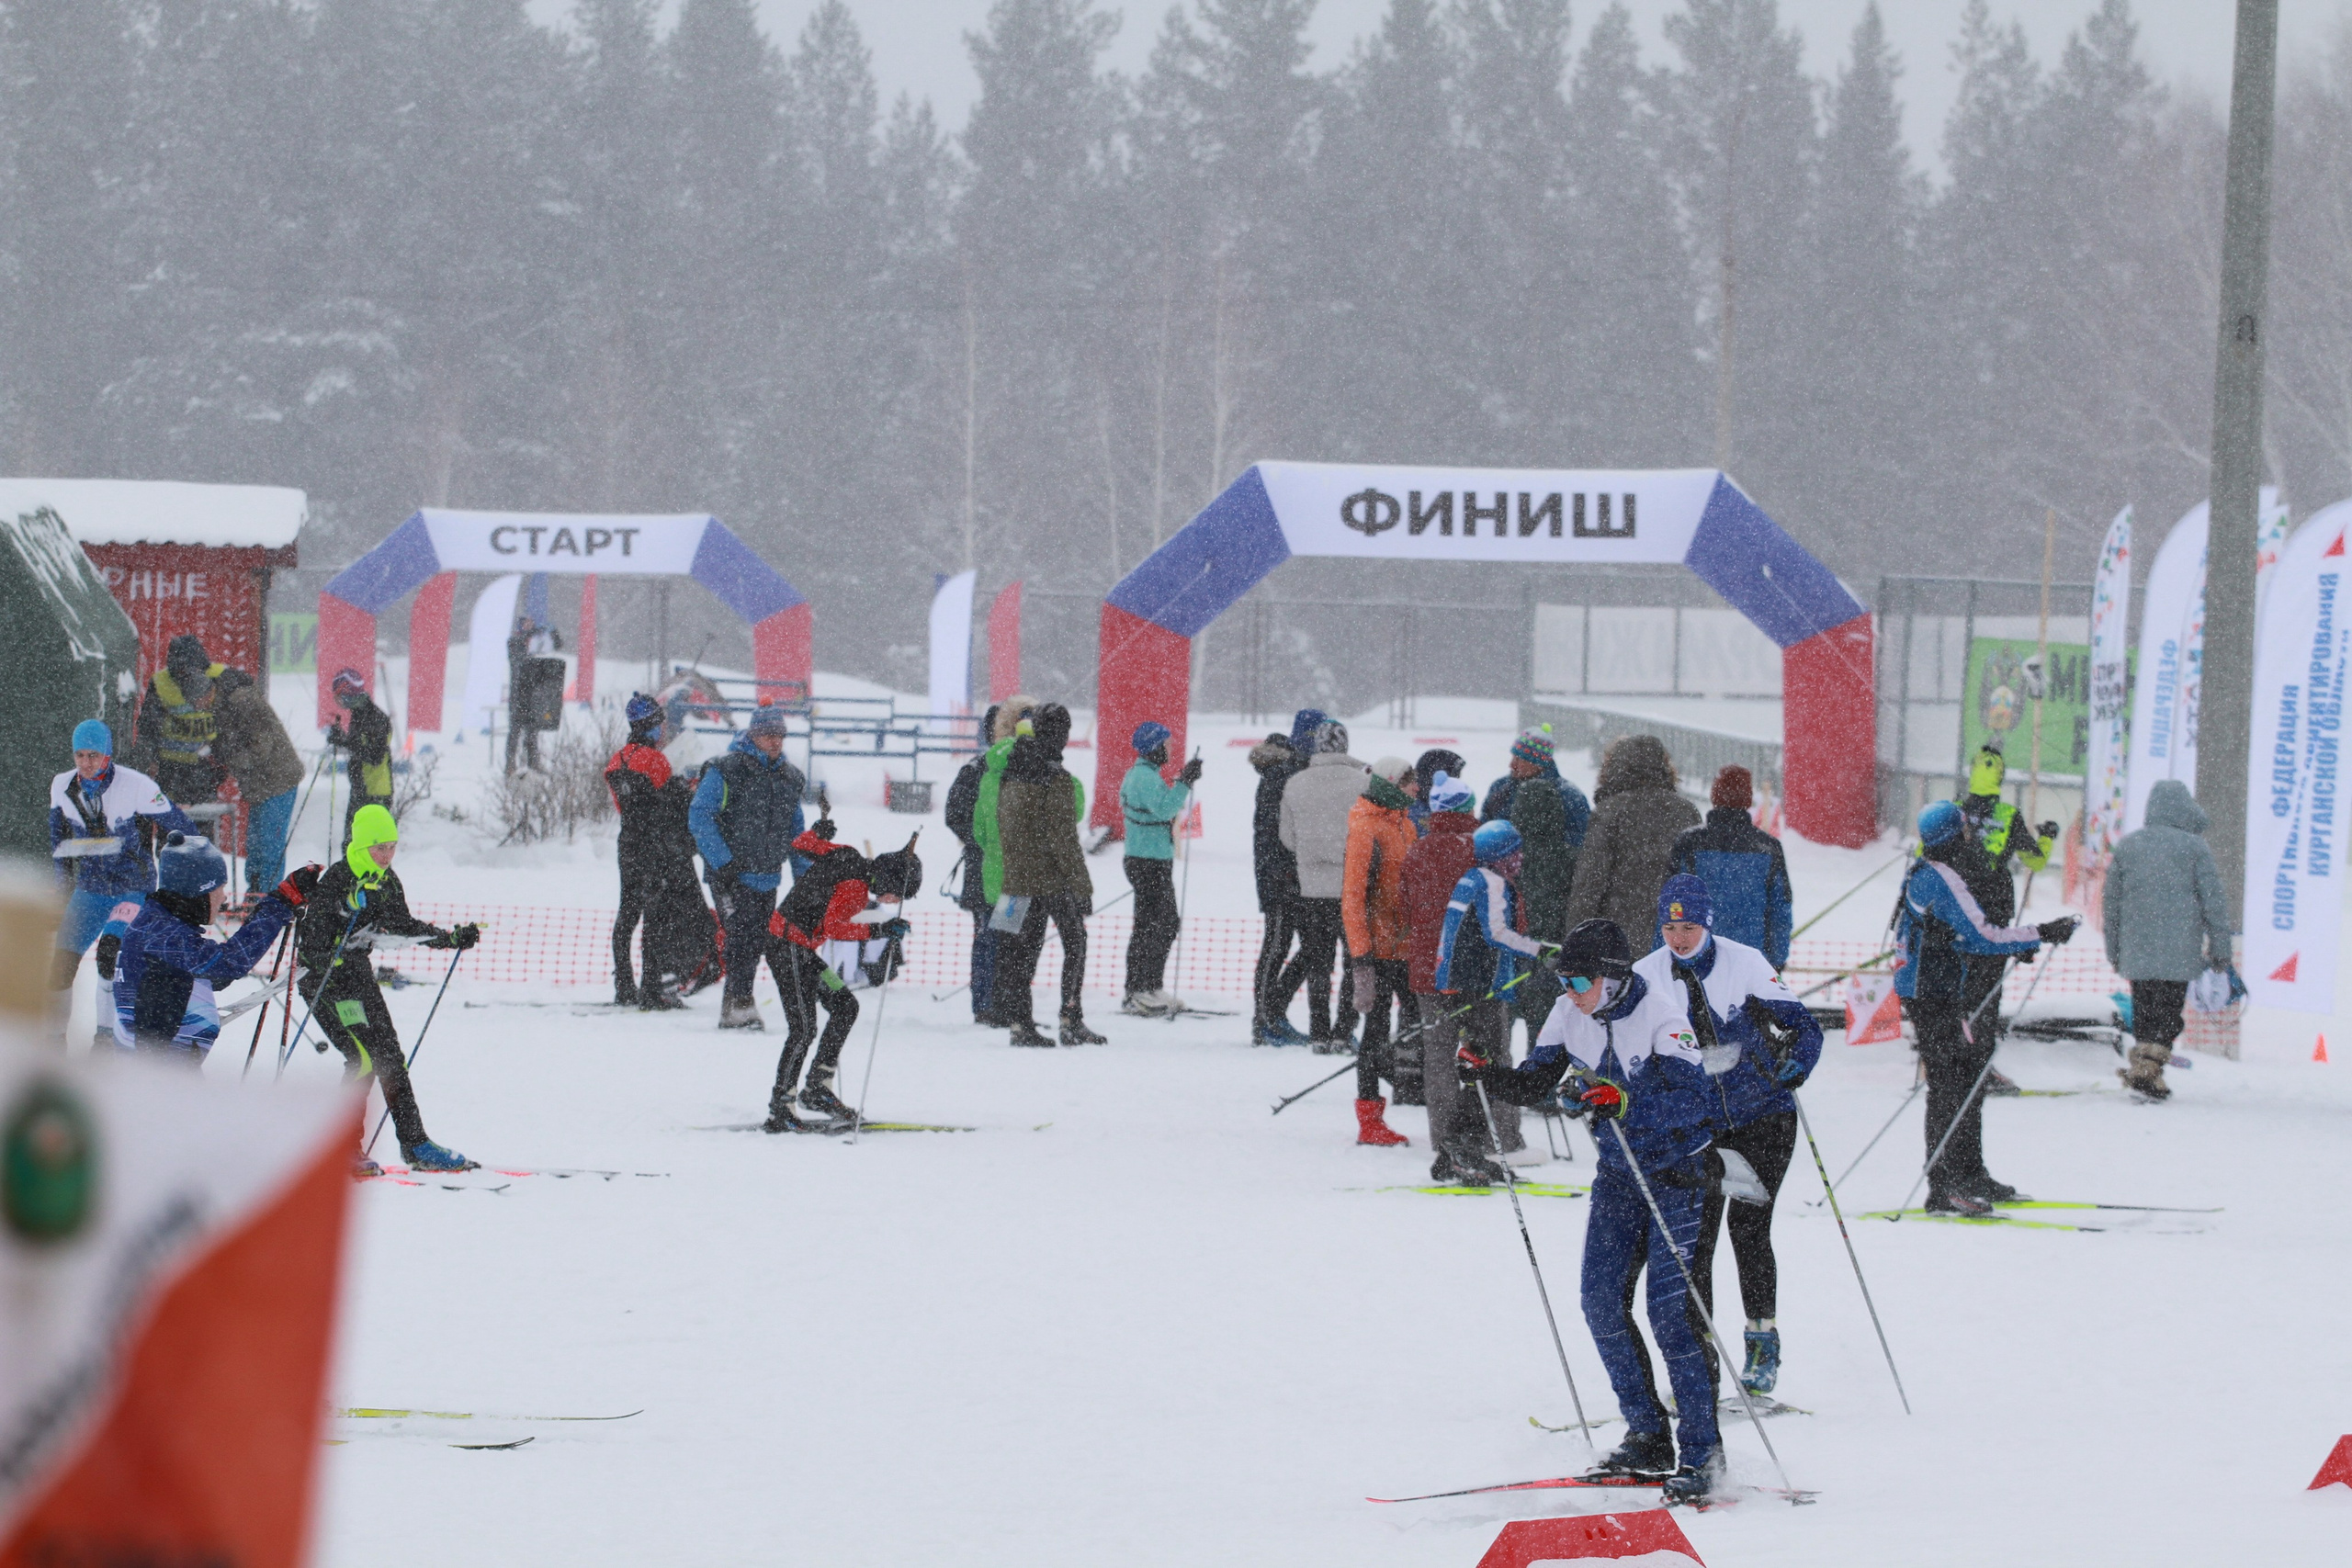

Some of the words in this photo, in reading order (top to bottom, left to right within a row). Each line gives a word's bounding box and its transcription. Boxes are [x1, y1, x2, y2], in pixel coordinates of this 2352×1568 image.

[1340, 488, 1635, 538] ФИНИШ
[490, 525, 640, 557] СТАРТ
[2270, 684, 2300, 818] ФЕДЕРАЦИЯ
